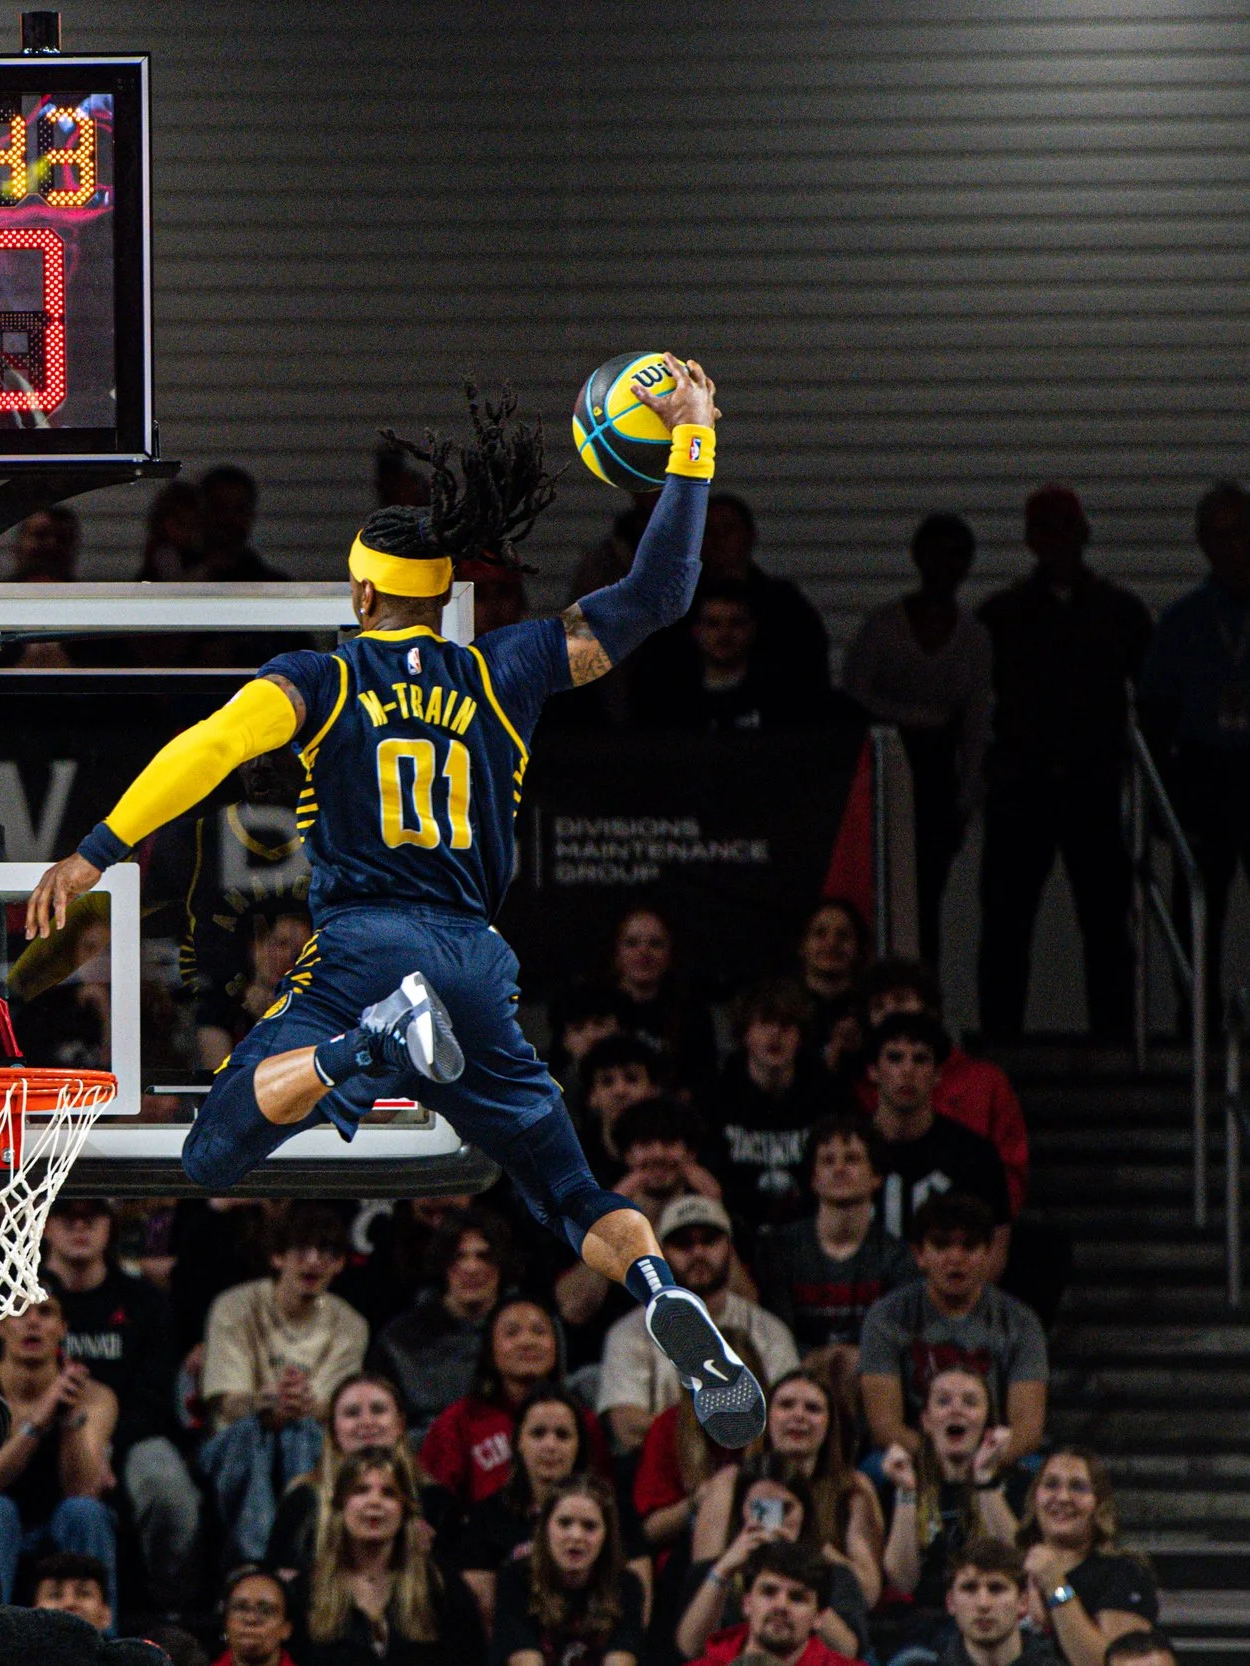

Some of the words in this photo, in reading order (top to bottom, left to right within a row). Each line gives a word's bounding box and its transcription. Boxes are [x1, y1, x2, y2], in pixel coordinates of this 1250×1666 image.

[357, 682, 478, 736] N-TRAIN
[376, 737, 473, 850] 01
[554, 816, 699, 837] DIVISIONS
[554, 838, 770, 862] MAINTENANCE
[554, 862, 661, 884] GROUP
